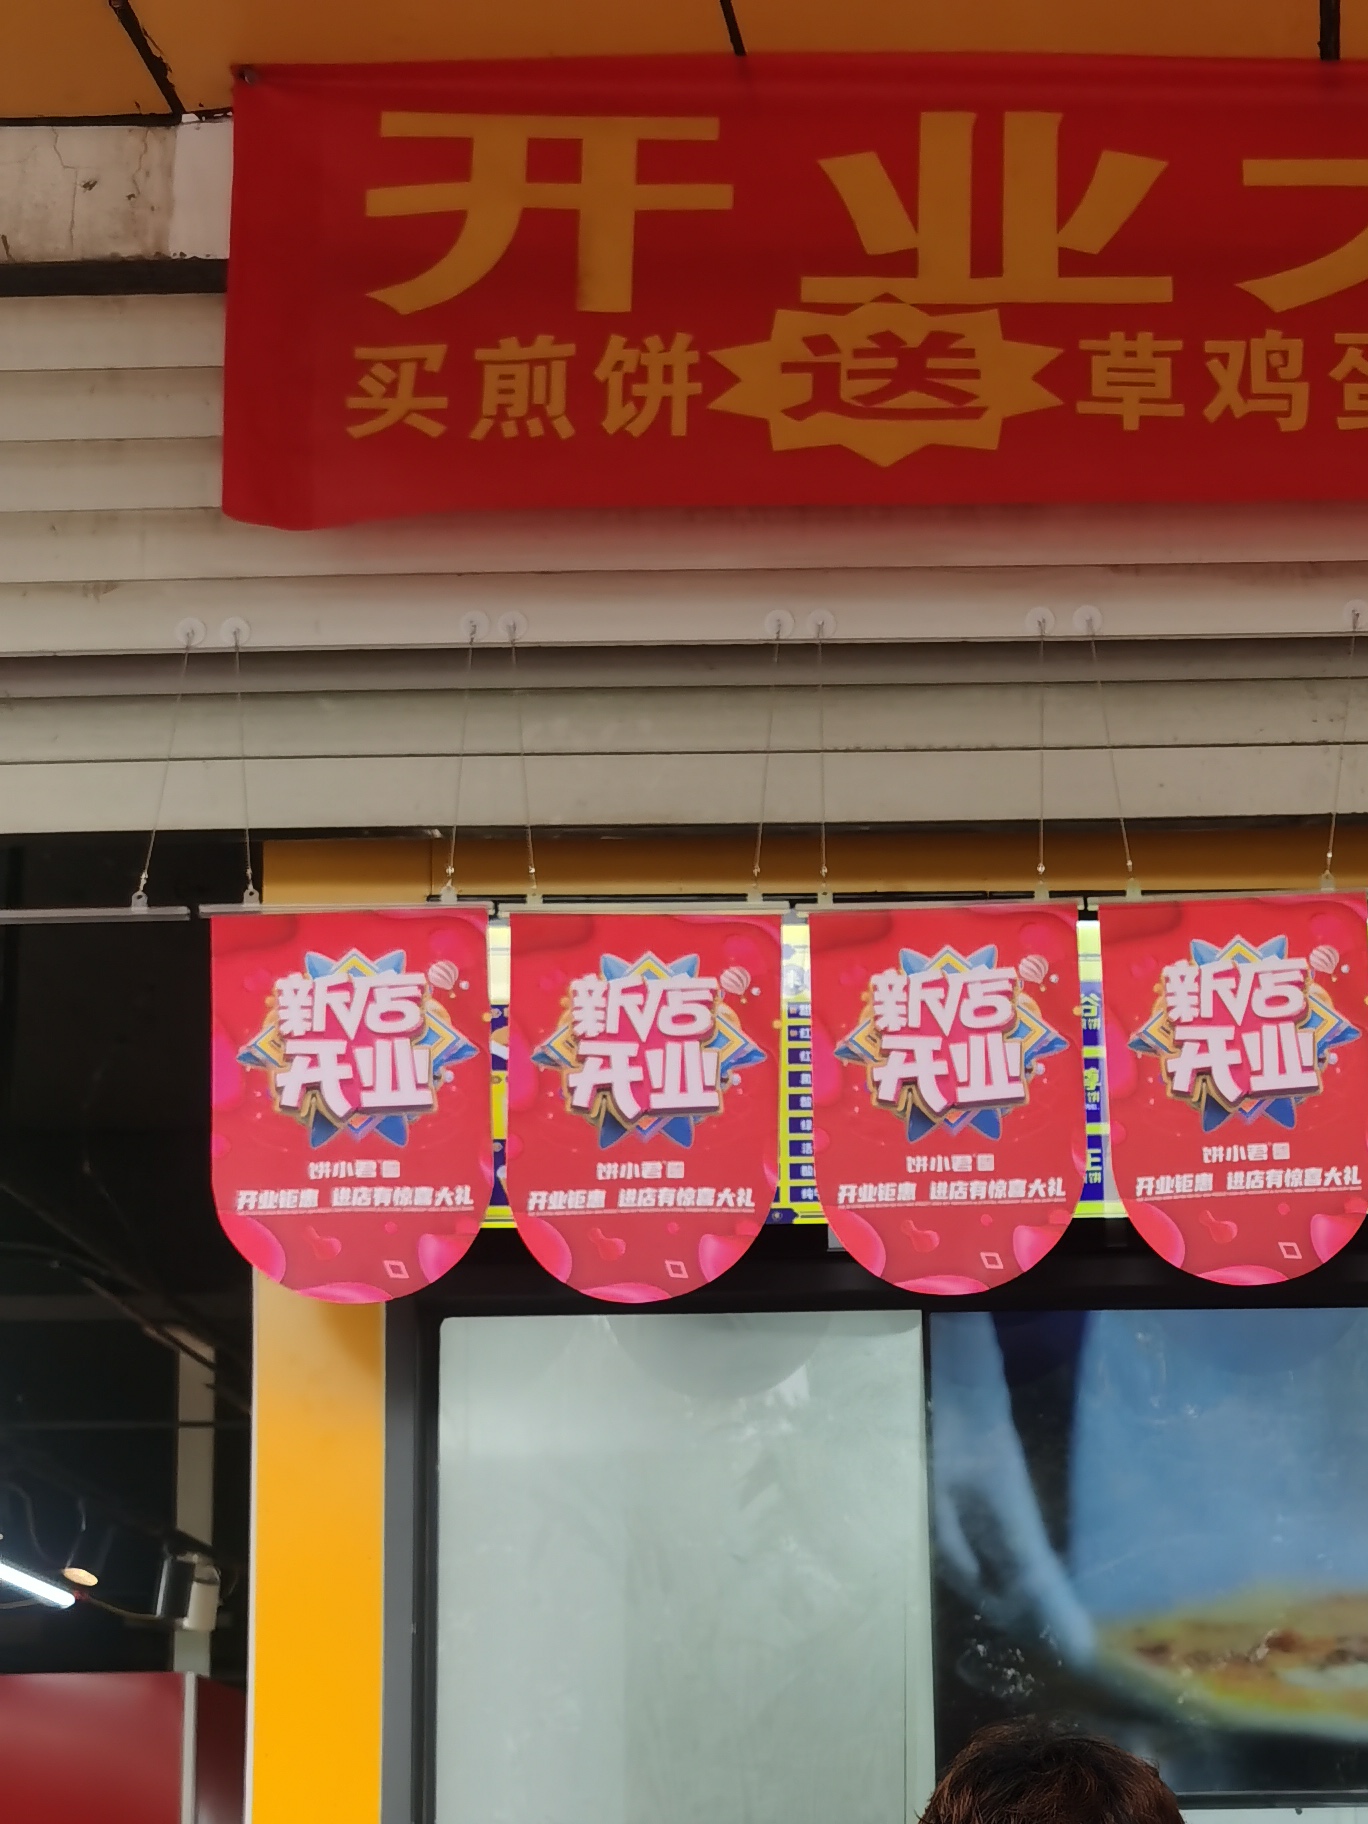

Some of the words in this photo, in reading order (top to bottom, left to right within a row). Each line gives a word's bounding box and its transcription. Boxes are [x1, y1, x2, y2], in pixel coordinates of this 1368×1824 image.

[345, 333, 702, 440] 买煎饼
[781, 329, 989, 422] 送
[274, 972, 428, 1041] 新店
[569, 973, 718, 1042] 新店
[870, 966, 1017, 1035] 新店
[1162, 957, 1309, 1027] 新店
[274, 1038, 434, 1118] 开业
[569, 1040, 721, 1118] 开业
[872, 1034, 1025, 1113] 开业
[1165, 1023, 1318, 1111] 开业
